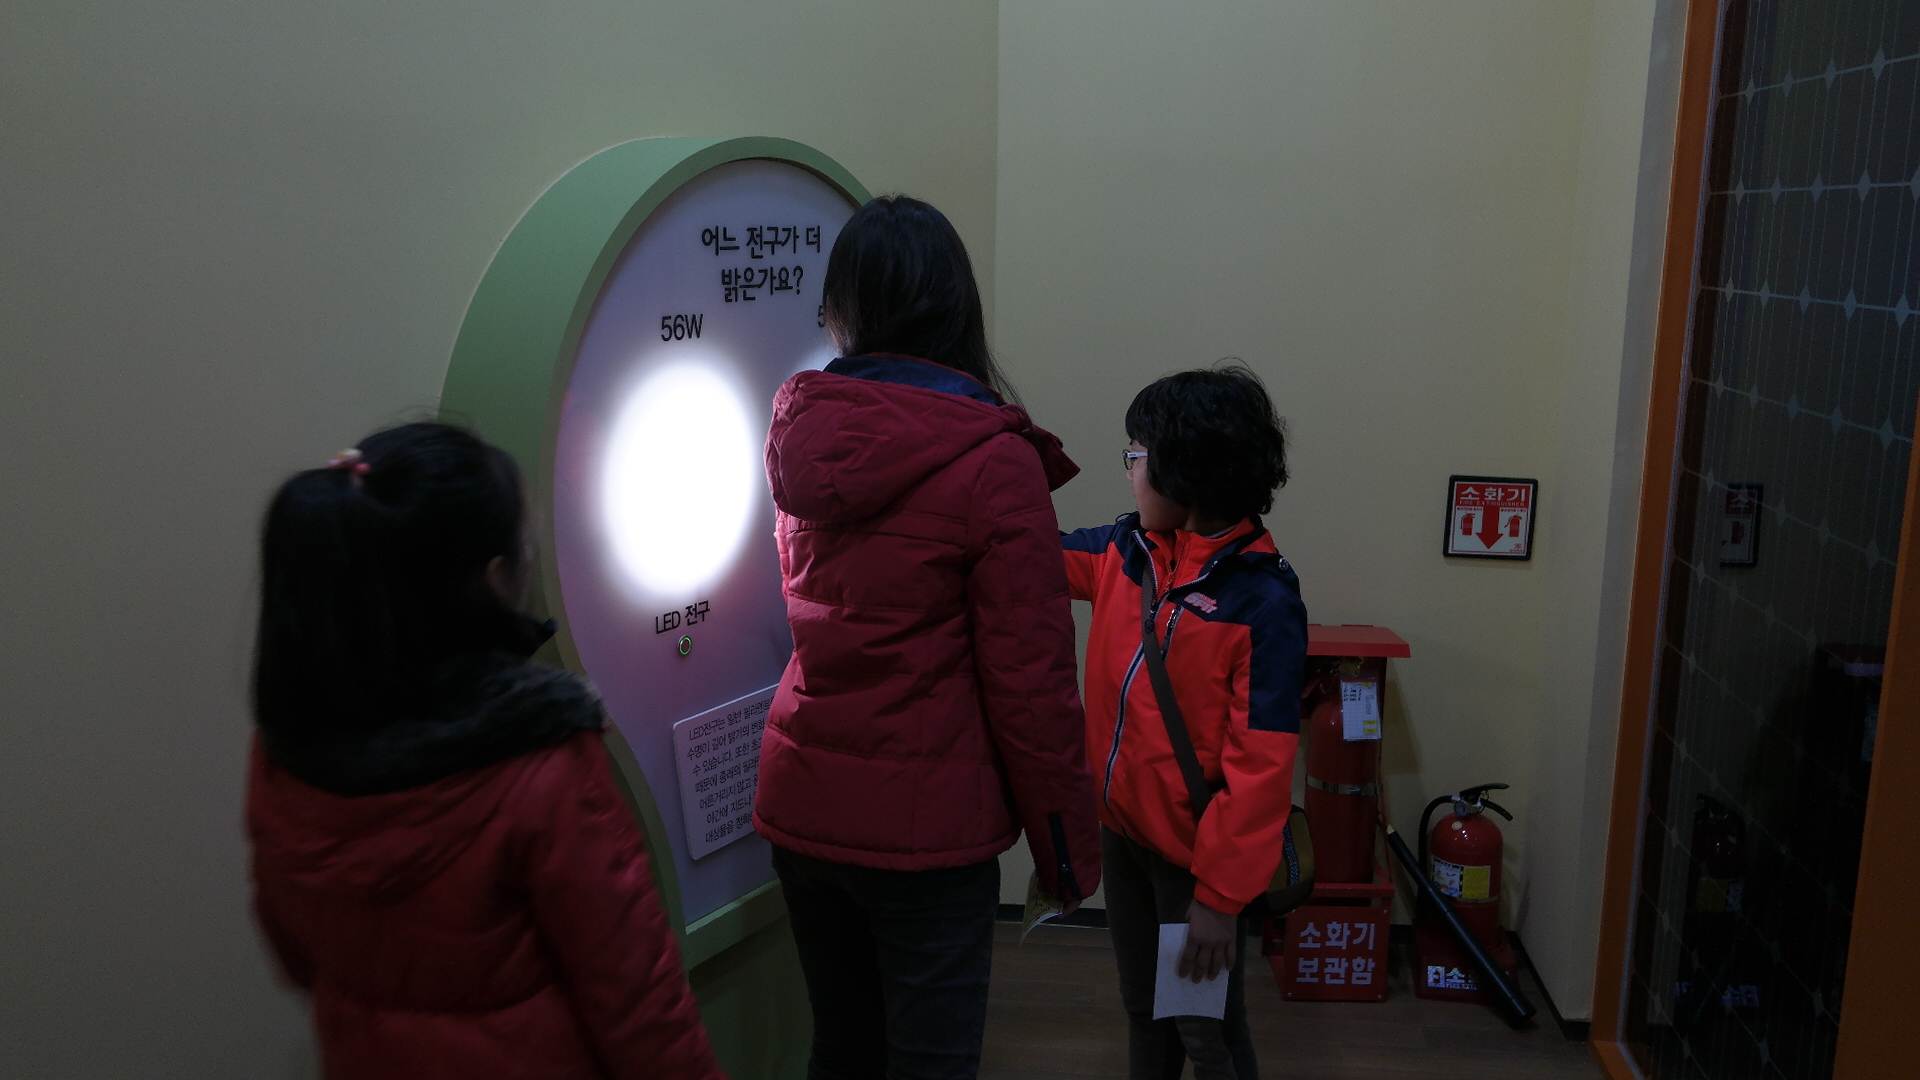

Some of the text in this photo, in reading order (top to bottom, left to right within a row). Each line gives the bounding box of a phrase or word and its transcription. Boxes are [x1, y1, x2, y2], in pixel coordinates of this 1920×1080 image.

[701, 225, 821, 259] 어느 전구가 더
[721, 265, 804, 303] 밝은가요?
[660, 313, 704, 342] 56W
[1459, 486, 1526, 502] 소화기
[655, 599, 711, 634] LED 전구
[689, 696, 773, 741] LED전구는 일반 필라멘트
[686, 740, 710, 760] 수명이
[712, 733, 726, 751] 길어
[727, 724, 750, 744] 밝기의
[692, 764, 701, 776] 수
[702, 750, 733, 773] 있습니다.
[735, 742, 750, 759] 또한
[695, 774, 718, 793] 때문에
[719, 763, 741, 784] 종래의
[698, 783, 736, 809] 어른거리지
[737, 778, 751, 794] 않고
[706, 804, 728, 824] 야간에
[705, 820, 734, 843] 대상물을
[1298, 921, 1376, 951] 소화기
[1296, 956, 1376, 985] 보관함
[1446, 967, 1470, 983] 소
